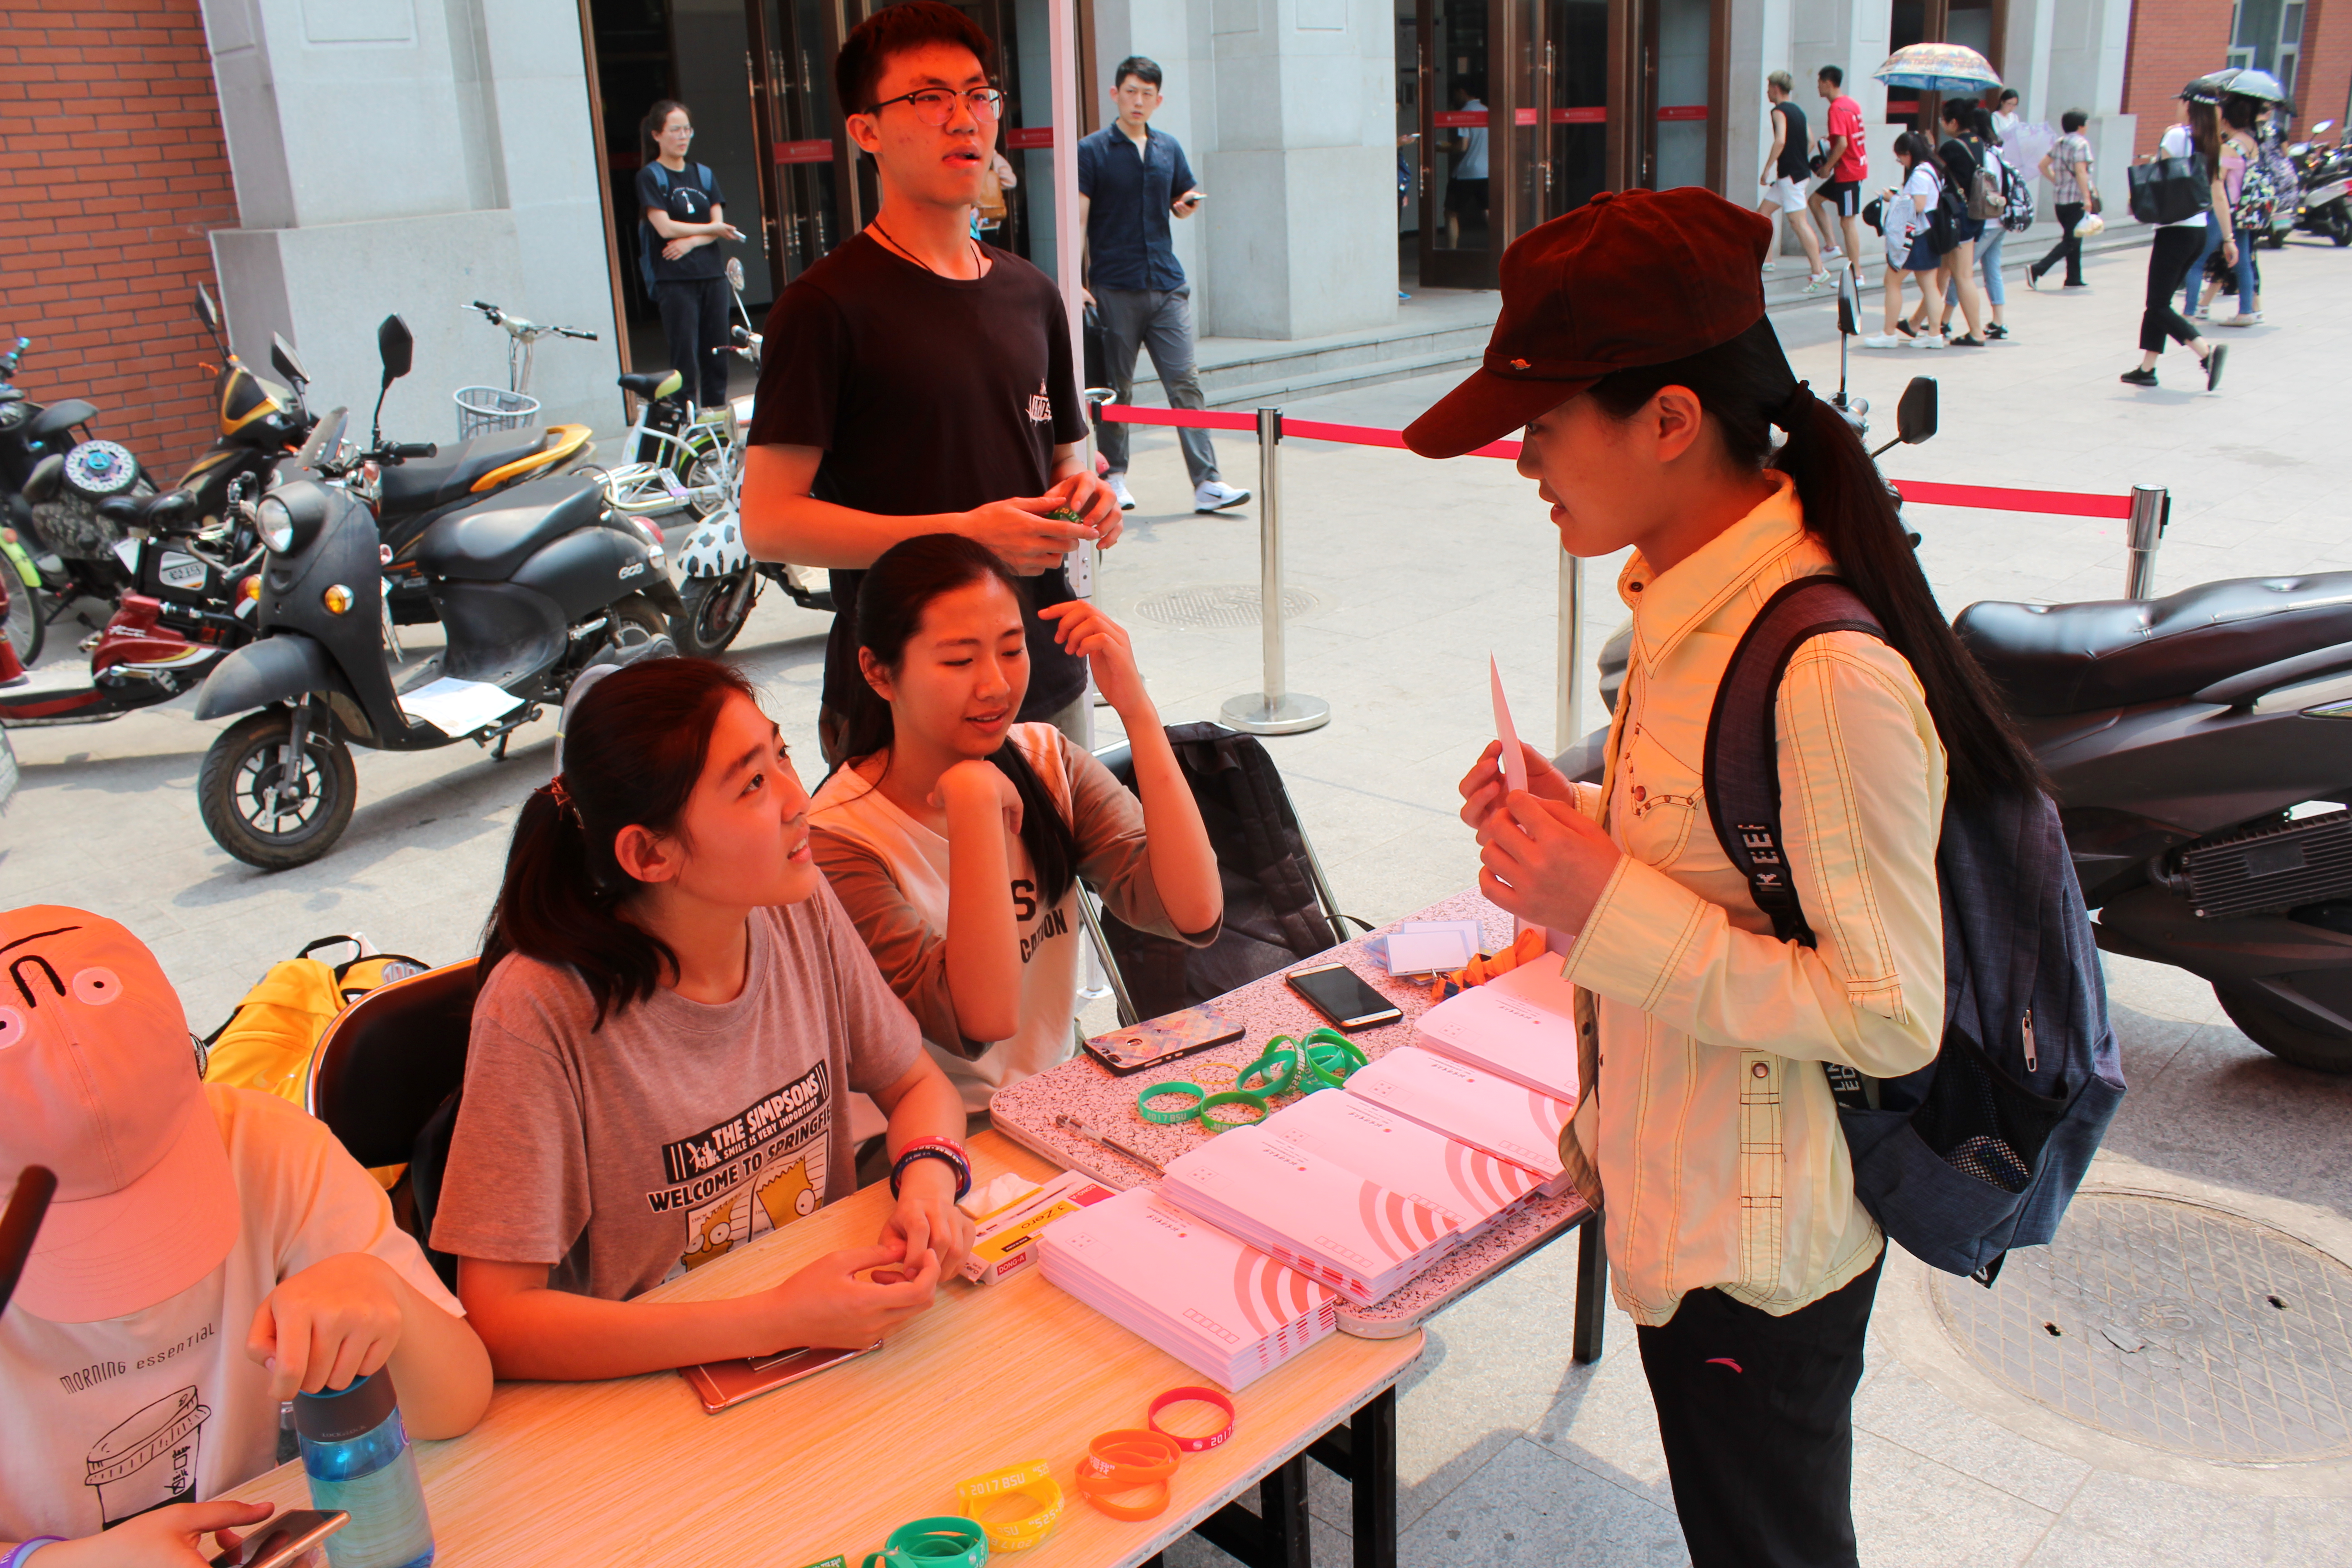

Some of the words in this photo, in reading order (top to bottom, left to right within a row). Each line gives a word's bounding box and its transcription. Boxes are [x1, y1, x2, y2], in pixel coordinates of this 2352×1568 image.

[712, 1118, 745, 1151] THE
[746, 1073, 819, 1134] SIMPSONS
[1147, 1112, 1168, 1121] 2017
[1170, 1112, 1187, 1121] BSU
[723, 1140, 747, 1159] SMILE
[749, 1135, 757, 1146] IS
[757, 1122, 777, 1141] VERY
[779, 1097, 818, 1128] IMPORTANT
[647, 1164, 739, 1212] WELCOME
[742, 1152, 763, 1176] TO
[59, 1362, 126, 1395] MORNING
[1210, 1426, 1231, 1447] 2017
[970, 1480, 999, 1496] 2017
[1001, 1473, 1025, 1489] BSU
[1000, 1539, 1033, 1549] 2017
